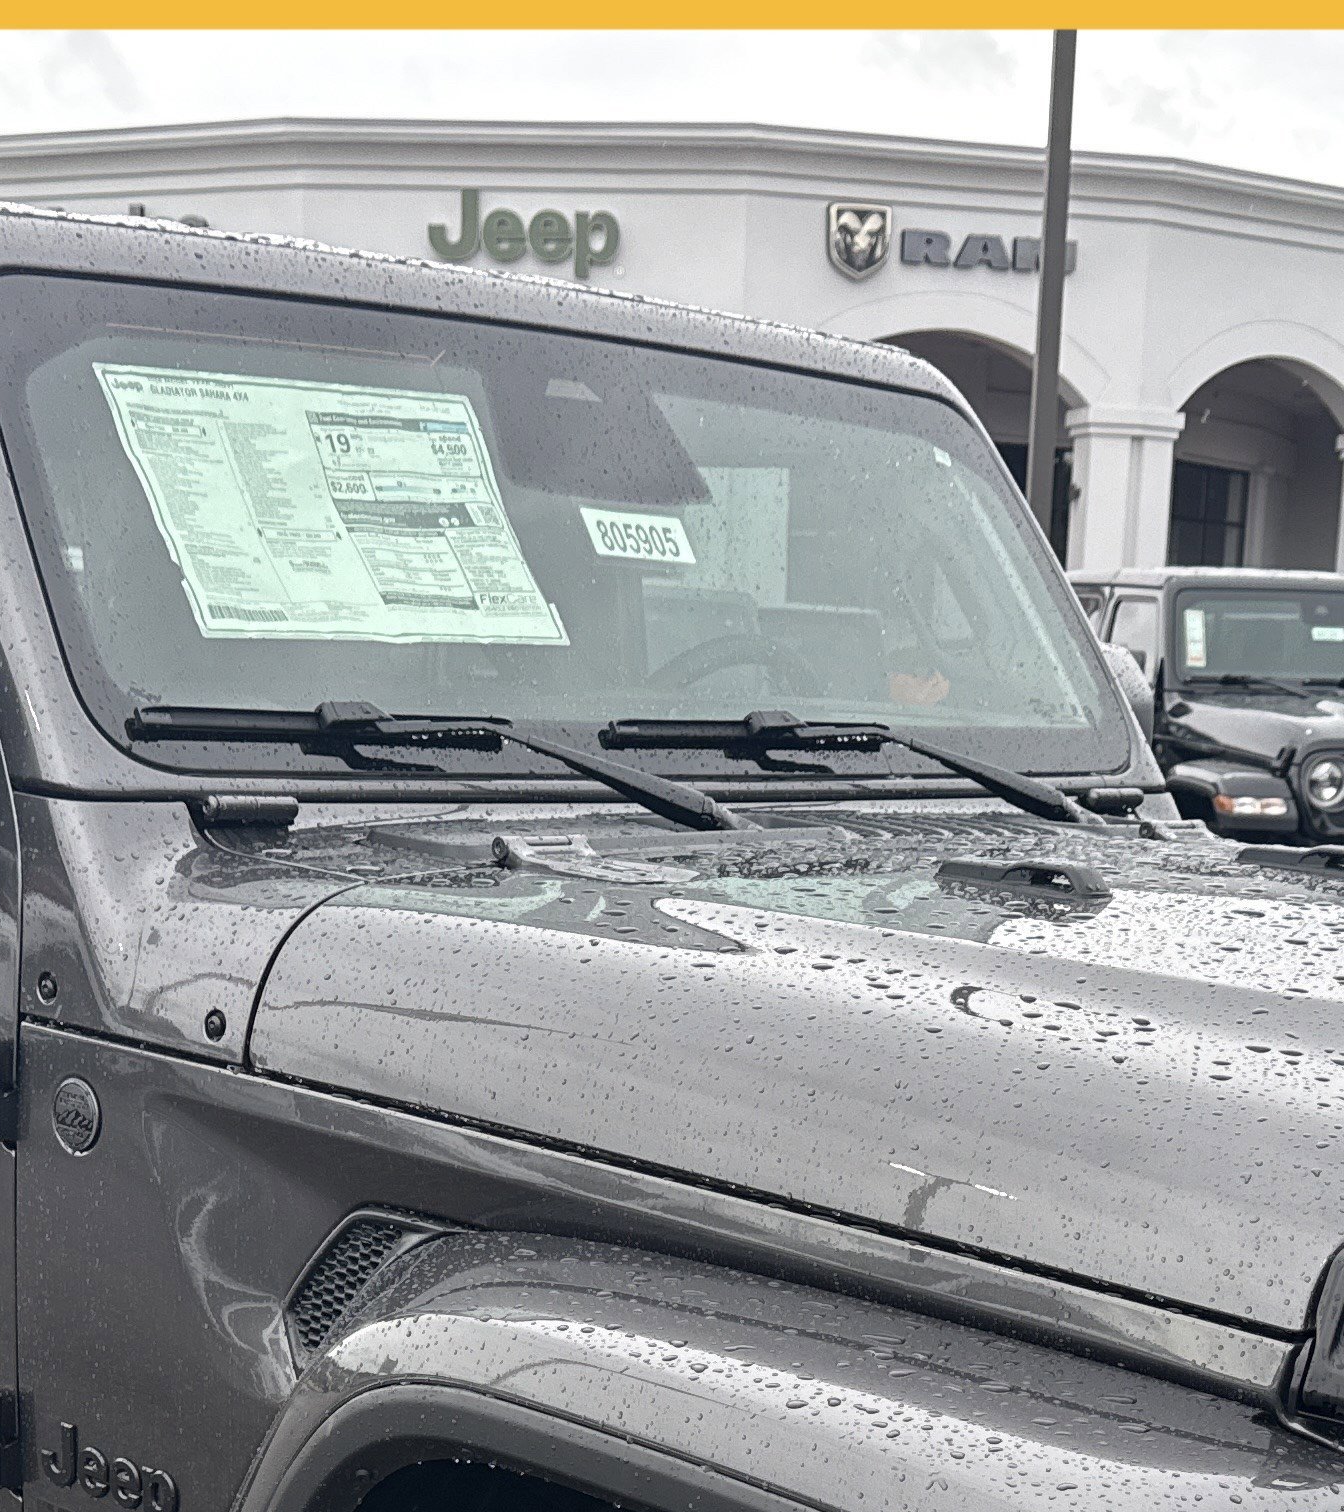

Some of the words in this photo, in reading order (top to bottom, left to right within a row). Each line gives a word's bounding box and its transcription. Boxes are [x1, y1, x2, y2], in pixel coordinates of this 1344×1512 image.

[428, 188, 621, 279] Jeep
[150, 384, 197, 397] GLADIATOR
[199, 388, 231, 402] SAHARA
[325, 433, 351, 453] 19
[596, 519, 681, 558] 805905
[479, 593, 537, 605] FlexCare
